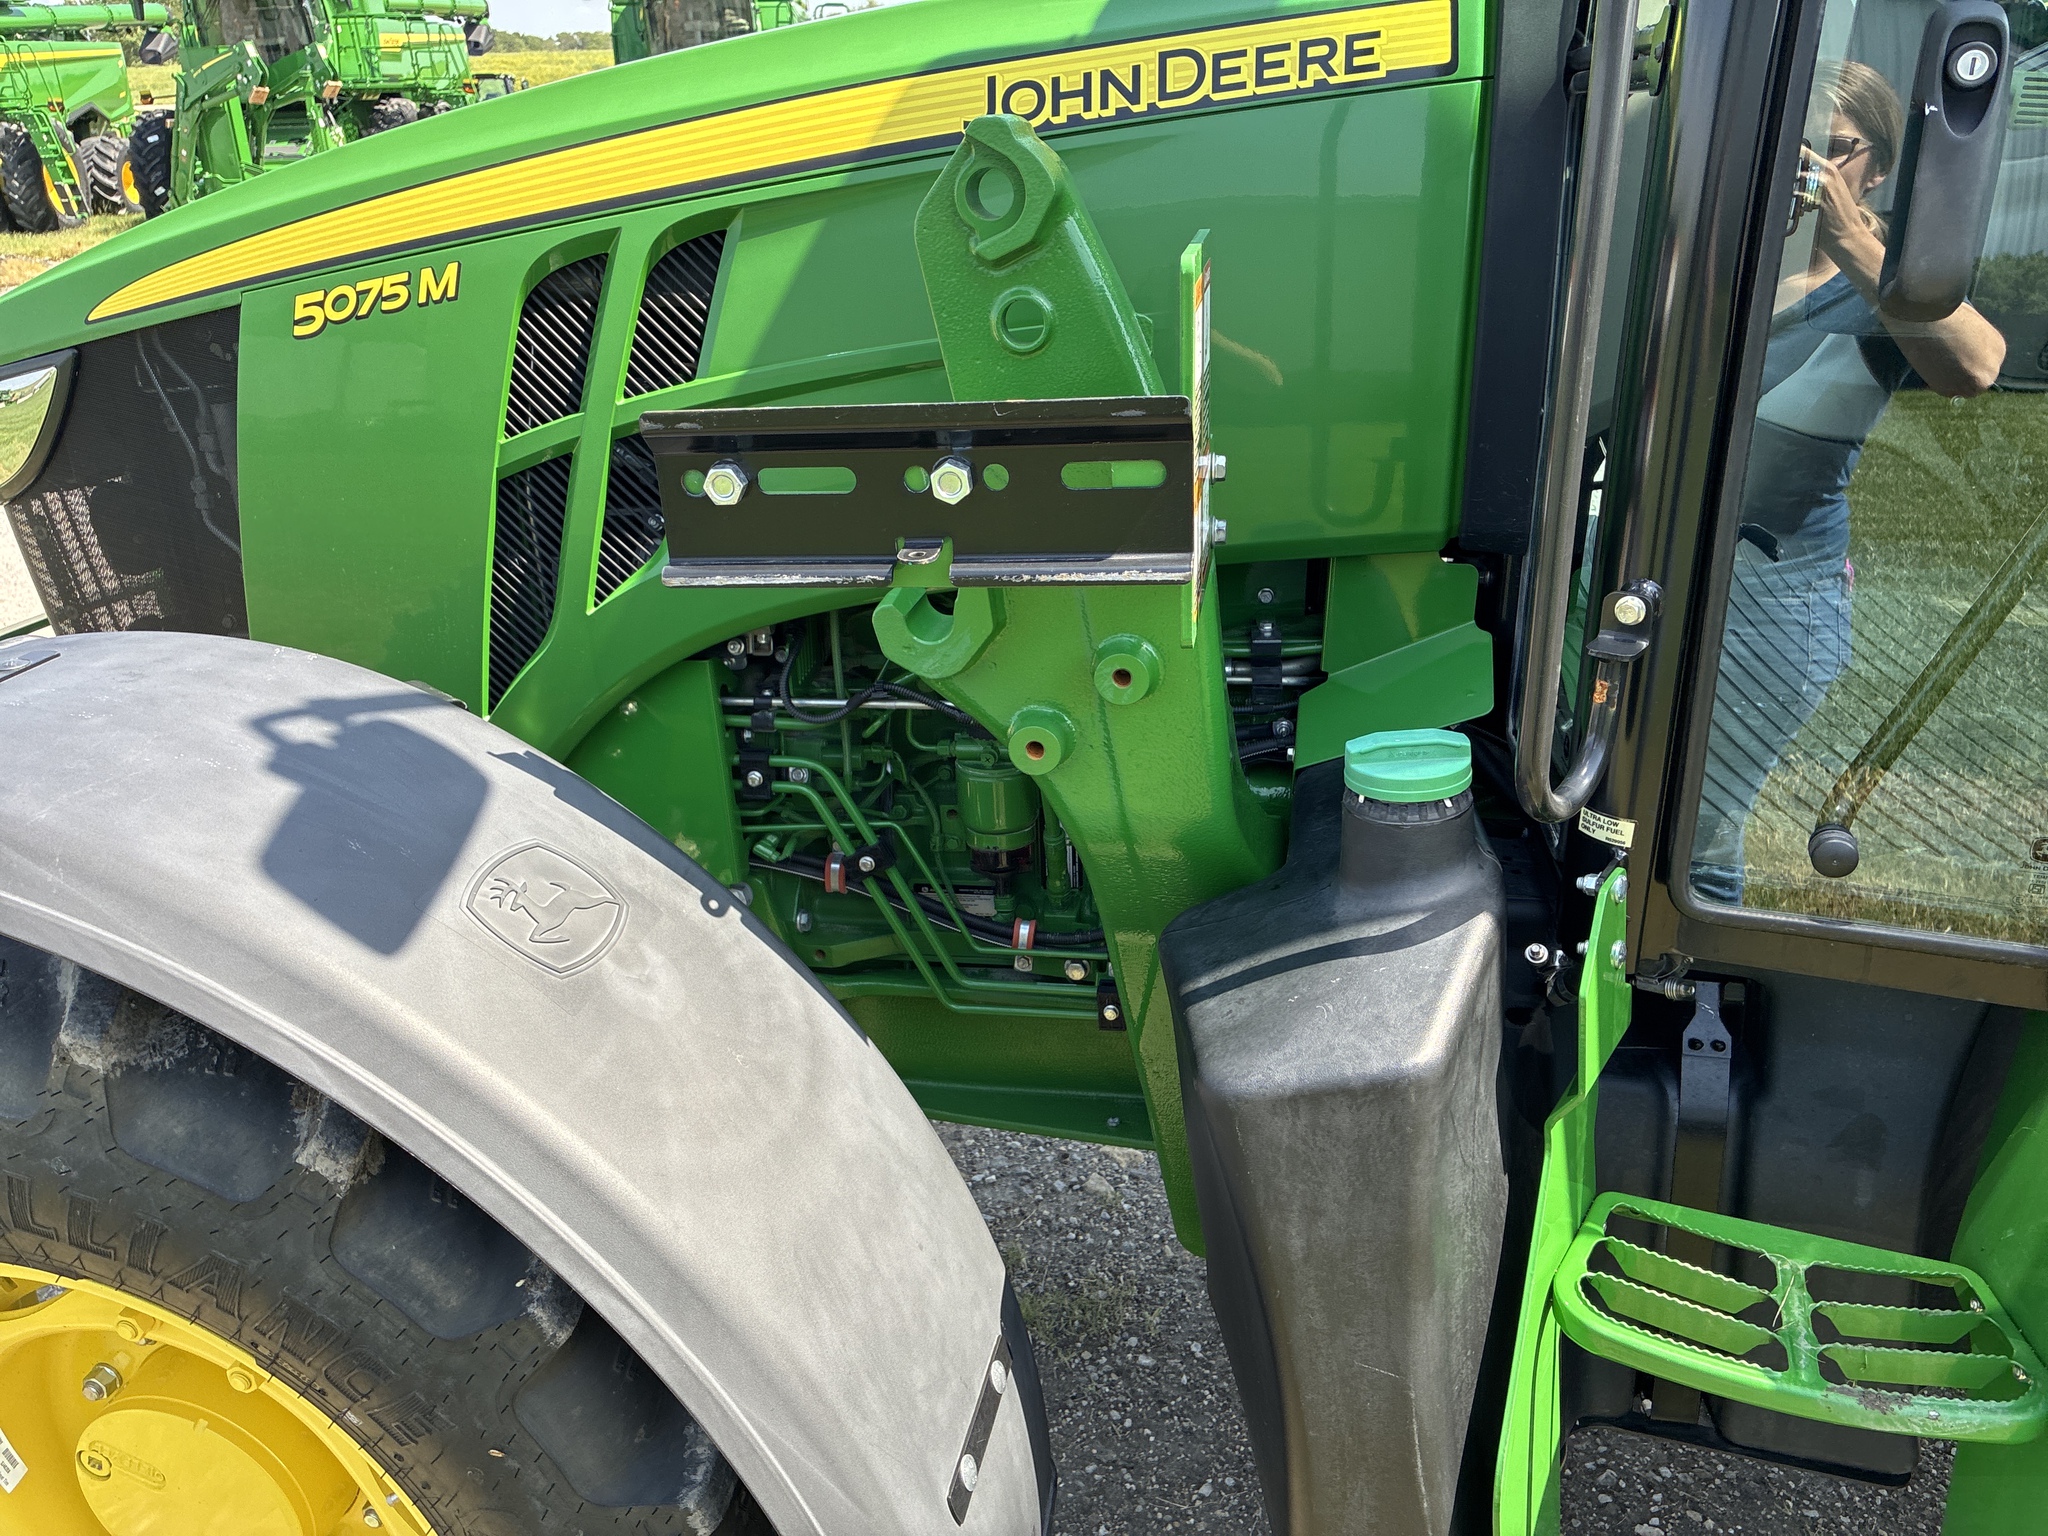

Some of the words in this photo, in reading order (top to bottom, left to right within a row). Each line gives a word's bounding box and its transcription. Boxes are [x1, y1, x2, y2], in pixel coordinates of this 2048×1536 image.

[964, 64, 1141, 127] JOHN
[1158, 30, 1382, 100] DEERE
[292, 271, 412, 340] 5075
[417, 260, 461, 308] M
[1580, 823, 1596, 835] ONLY
[1581, 815, 1605, 832] SULFUR
[1605, 826, 1625, 837] FUEL
[1582, 808, 1602, 823] ULTRA
[1602, 818, 1620, 828] LOW
[0, 1169, 456, 1447] LLIANCE
